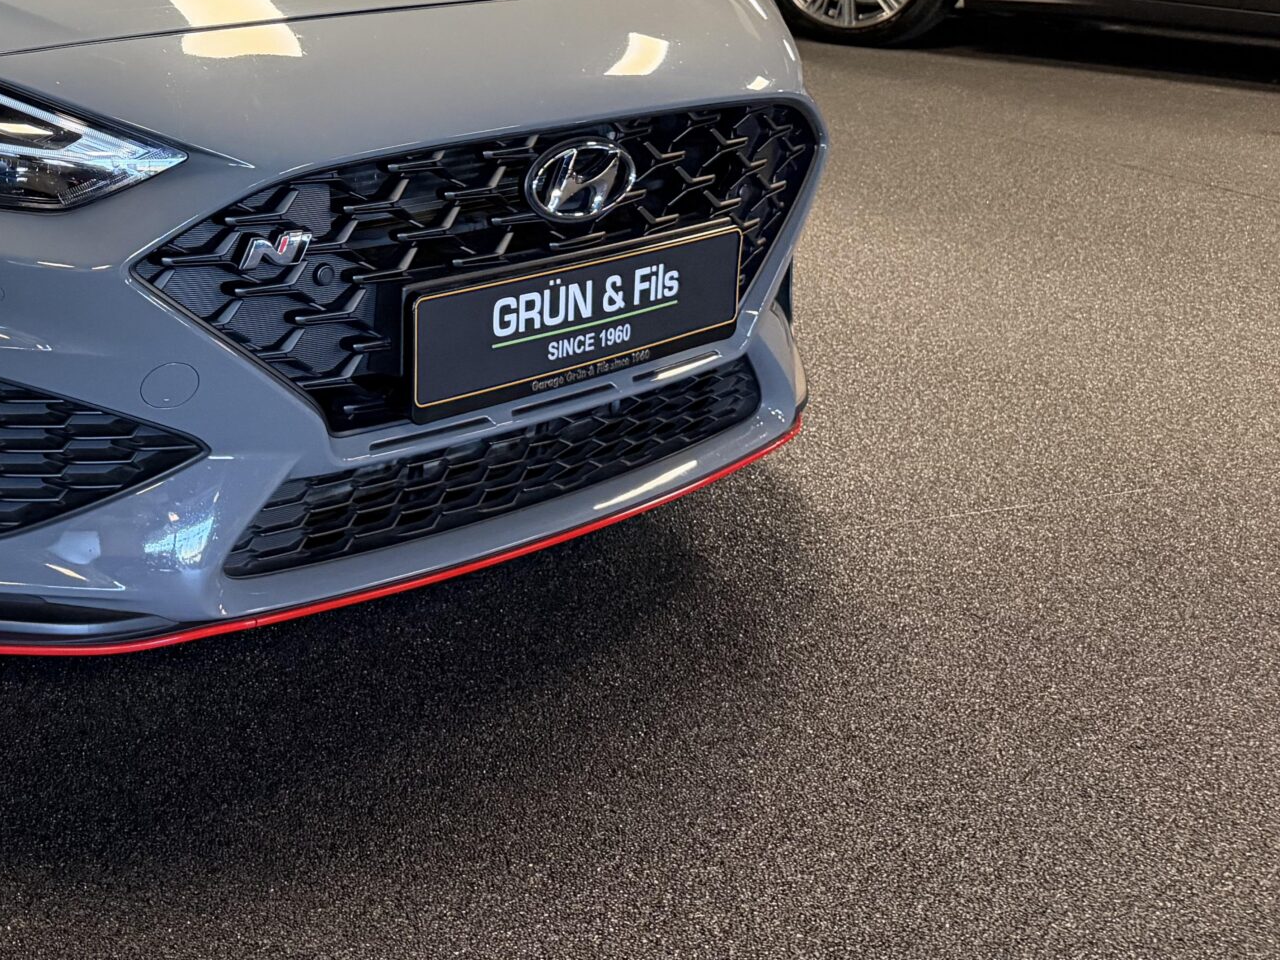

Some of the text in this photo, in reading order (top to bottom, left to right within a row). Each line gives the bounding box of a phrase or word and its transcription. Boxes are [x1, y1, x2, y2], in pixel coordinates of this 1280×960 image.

[240, 230, 312, 269] N
[493, 263, 679, 337] GRÜN & Fils
[548, 323, 631, 361] SINCE 1960
[531, 375, 564, 391] Garage
[631, 349, 650, 363] 1960
